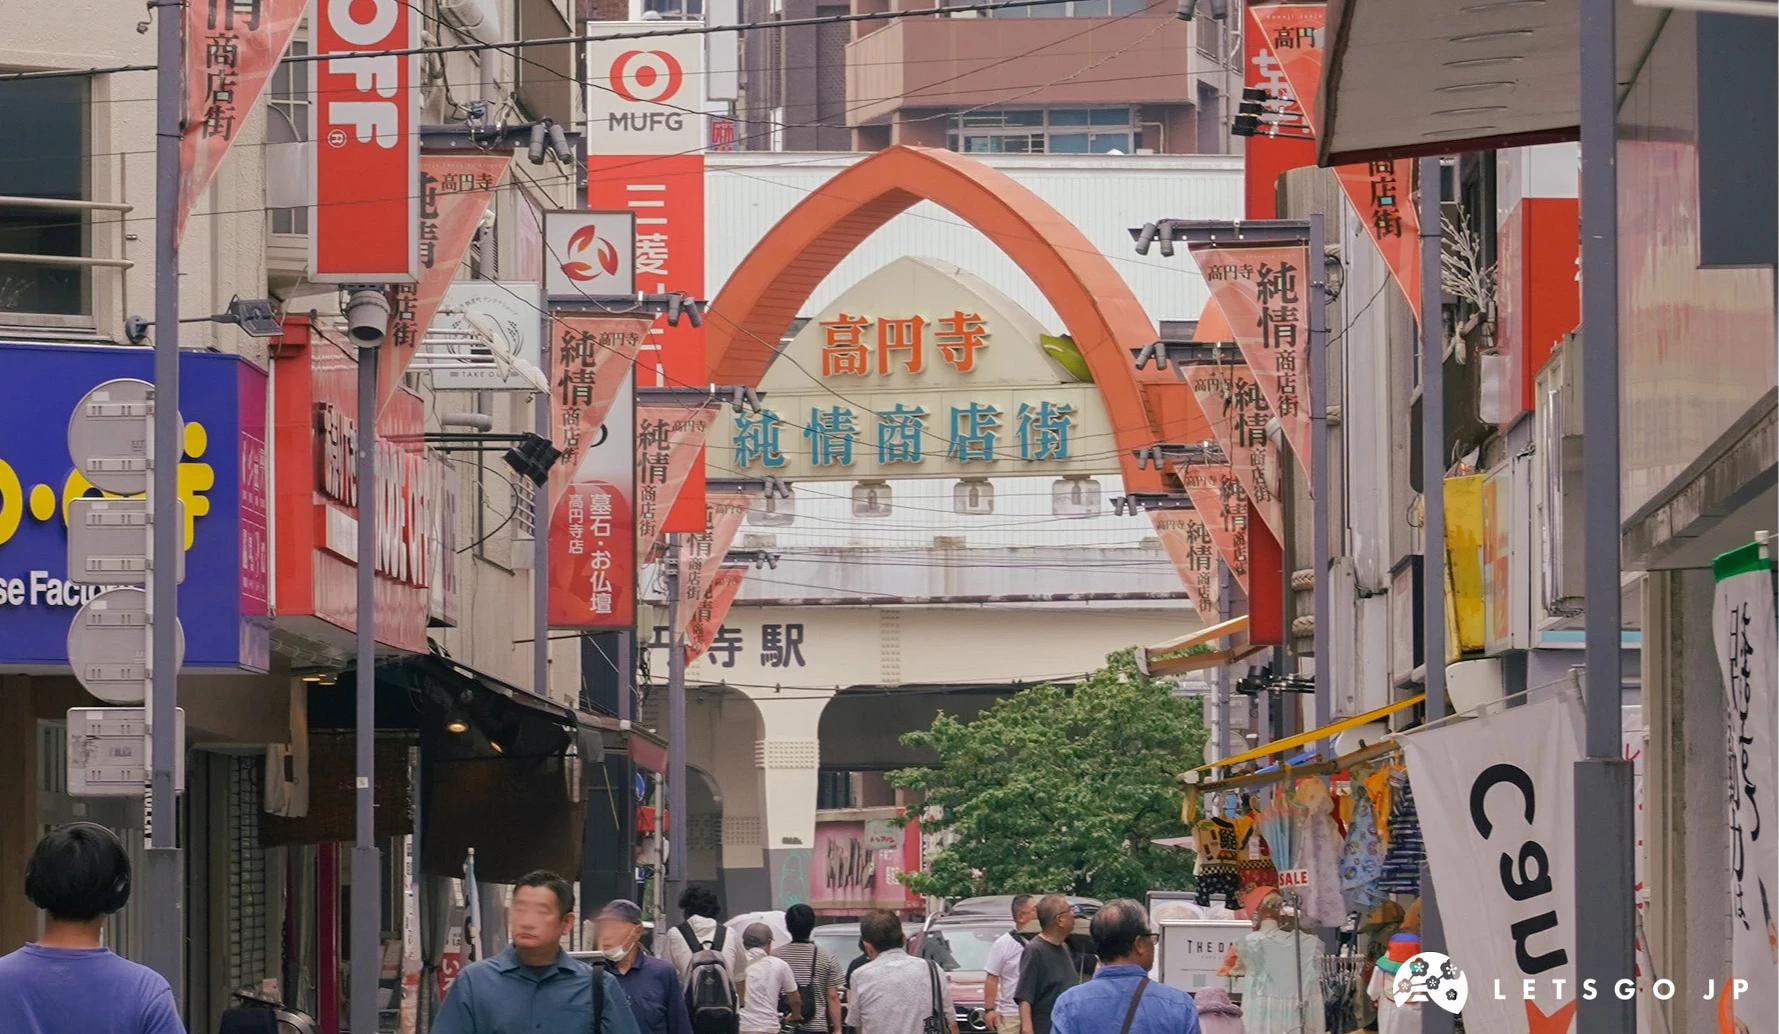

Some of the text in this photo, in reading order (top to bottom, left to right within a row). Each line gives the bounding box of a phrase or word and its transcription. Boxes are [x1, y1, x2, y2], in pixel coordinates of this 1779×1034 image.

[608, 112, 683, 132] MUFG
[441, 173, 493, 191] 高円寺
[1207, 264, 1254, 281] 高円寺
[599, 331, 639, 347] 高円寺
[819, 310, 990, 378] 高円寺
[1256, 261, 1300, 418] 純情商店街
[733, 400, 1079, 471] 純情商店街
[568, 494, 584, 555] 高円寺店
[589, 494, 613, 614] 墓石・お仏壇
[1280, 870, 1308, 887] SALE
[1187, 939, 1213, 953] THE
